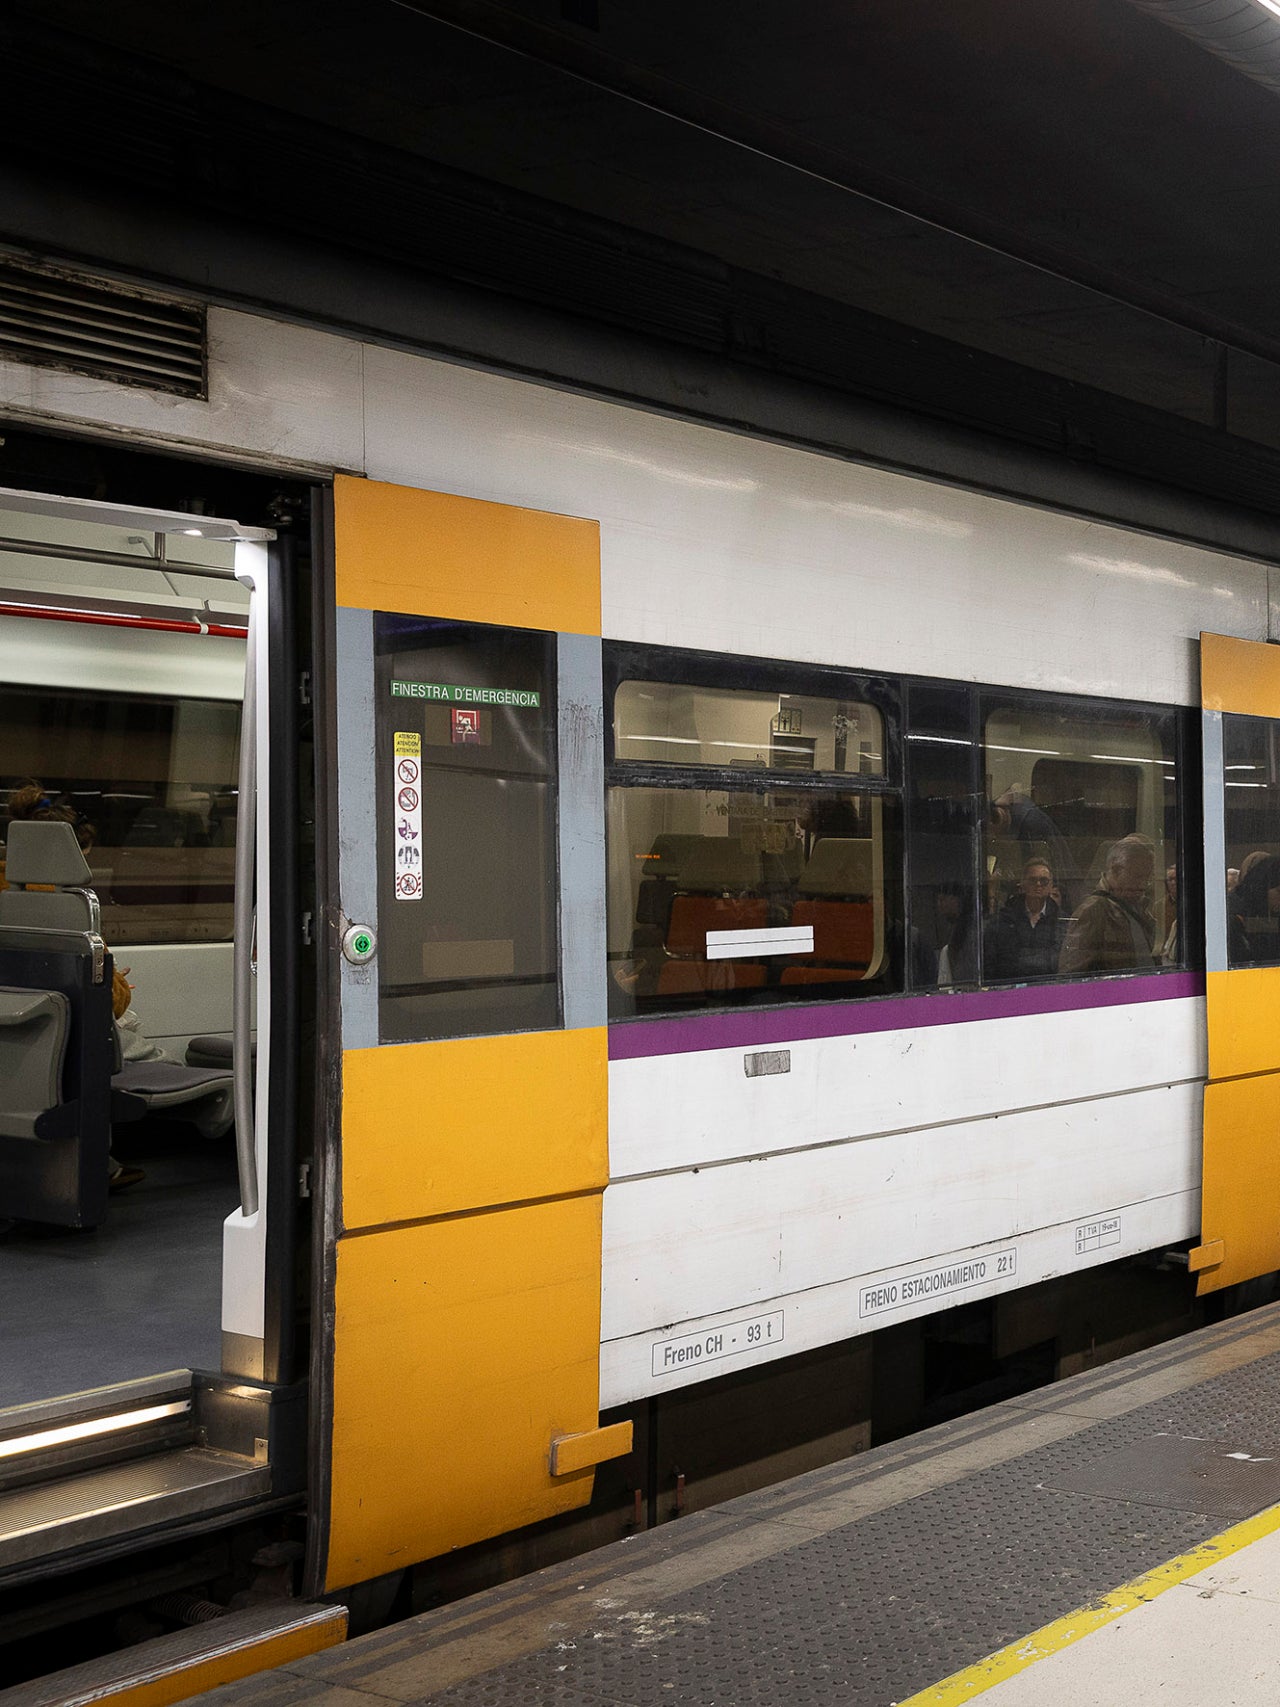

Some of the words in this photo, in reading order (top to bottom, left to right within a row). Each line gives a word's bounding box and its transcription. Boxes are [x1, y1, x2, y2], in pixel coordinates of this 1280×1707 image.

[392, 682, 449, 699] FINESTRA
[864, 1285, 898, 1311] FRENO
[901, 1261, 986, 1300] ESTACIONAMIENTO
[997, 1256, 1007, 1273] 22
[1009, 1254, 1013, 1270] t
[664, 1343, 702, 1366] Freno
[705, 1334, 723, 1355] CH
[747, 1323, 761, 1343] 93
[766, 1321, 772, 1337] t
